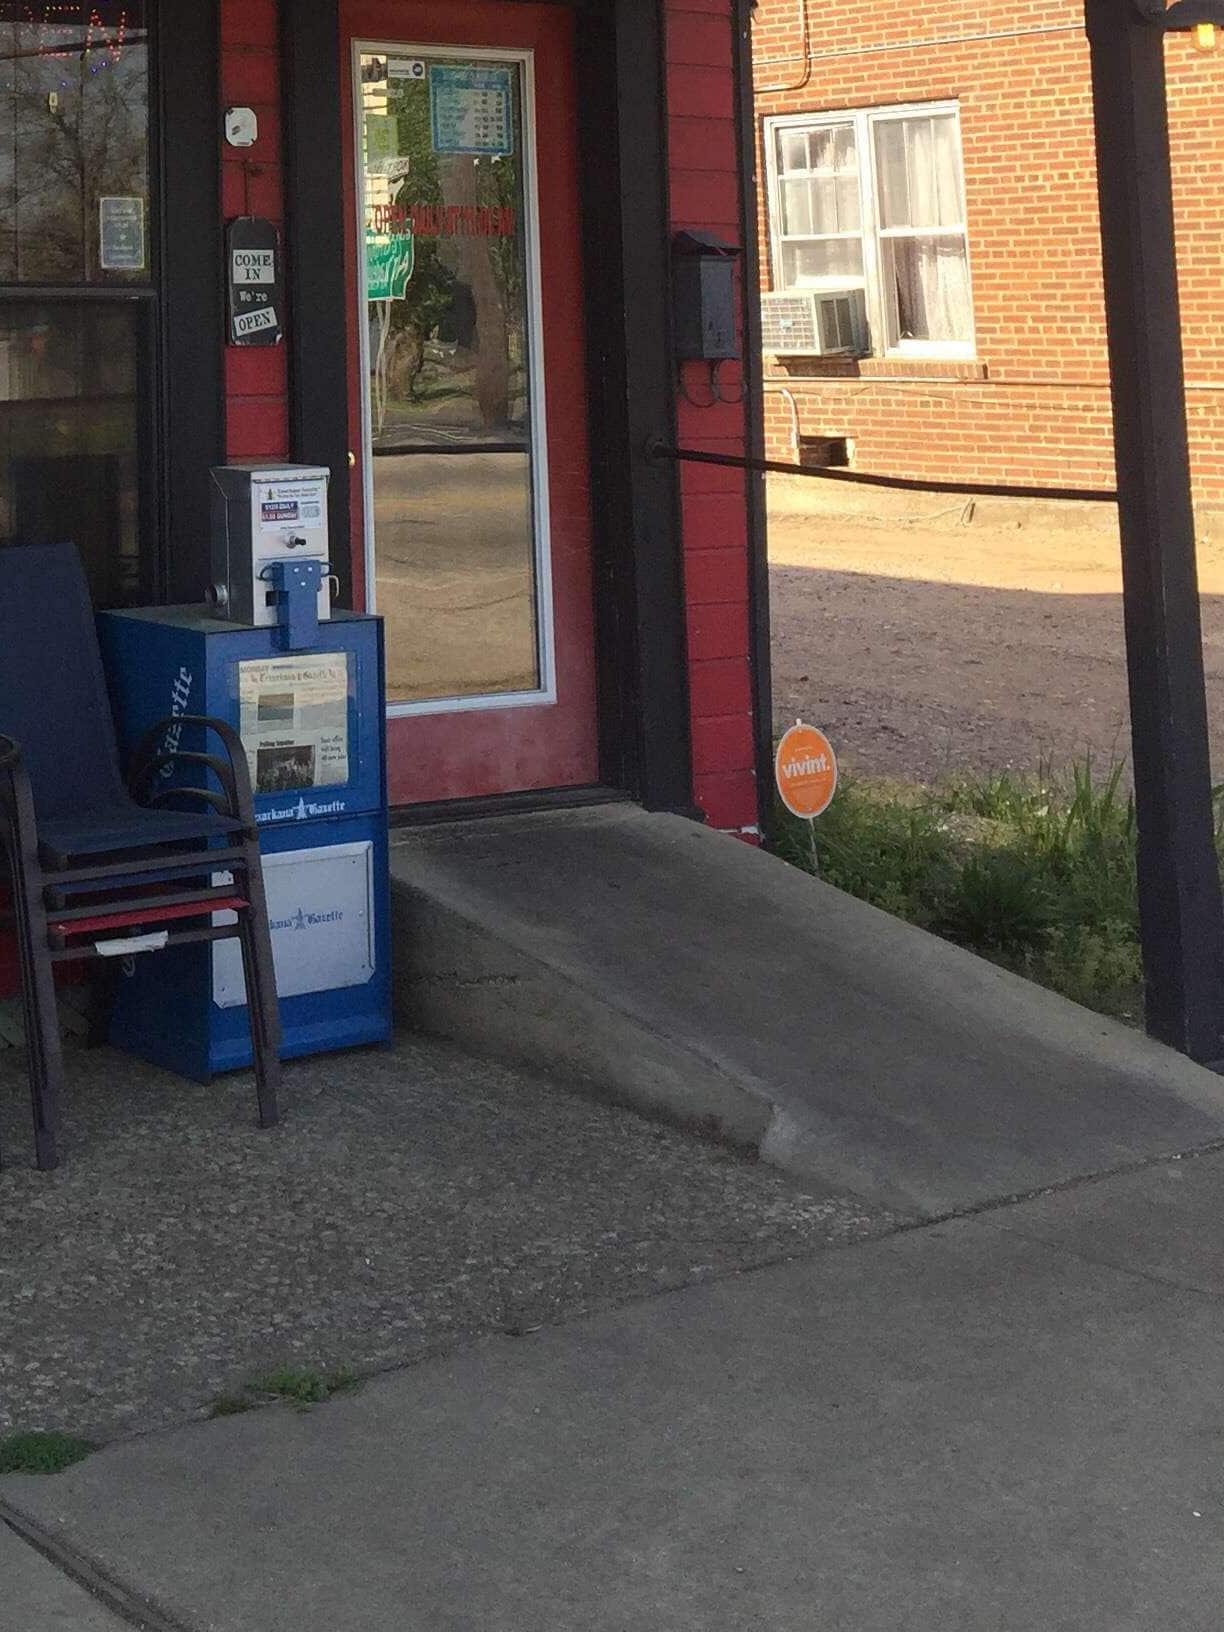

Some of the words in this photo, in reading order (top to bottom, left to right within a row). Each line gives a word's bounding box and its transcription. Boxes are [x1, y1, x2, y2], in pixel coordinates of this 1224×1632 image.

[234, 253, 272, 268] COME
[244, 268, 262, 280] IN
[239, 290, 268, 303] We're
[238, 311, 272, 332] OPEN
